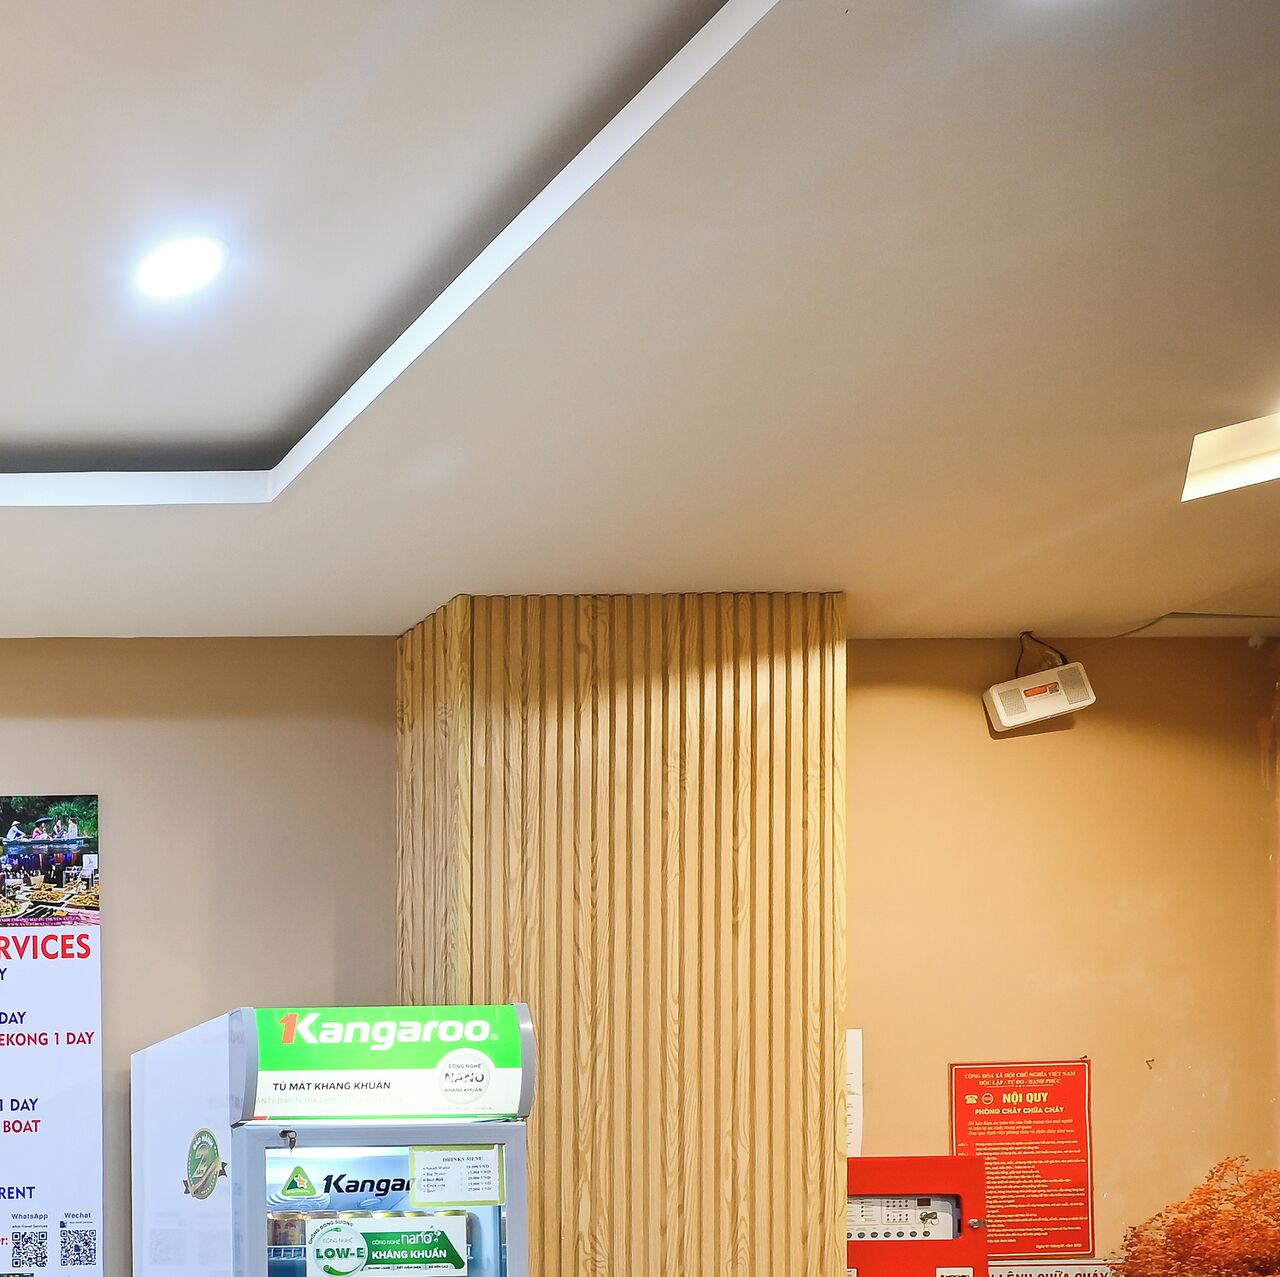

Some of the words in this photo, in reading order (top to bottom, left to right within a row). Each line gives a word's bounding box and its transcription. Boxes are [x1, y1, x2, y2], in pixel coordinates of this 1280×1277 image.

[54, 1032, 60, 1045] 1
[67, 1032, 95, 1045] DAY
[444, 1072, 484, 1083] NANO
[10, 1098, 38, 1111] DAY
[1002, 1091, 1022, 1105] NỘI
[1026, 1093, 1048, 1103] QUY
[3, 1120, 40, 1133] BOAT
[316, 1248, 364, 1259] LOW-E
[372, 1248, 408, 1259] KHÁNG
[411, 1247, 447, 1258] KHUẨN
